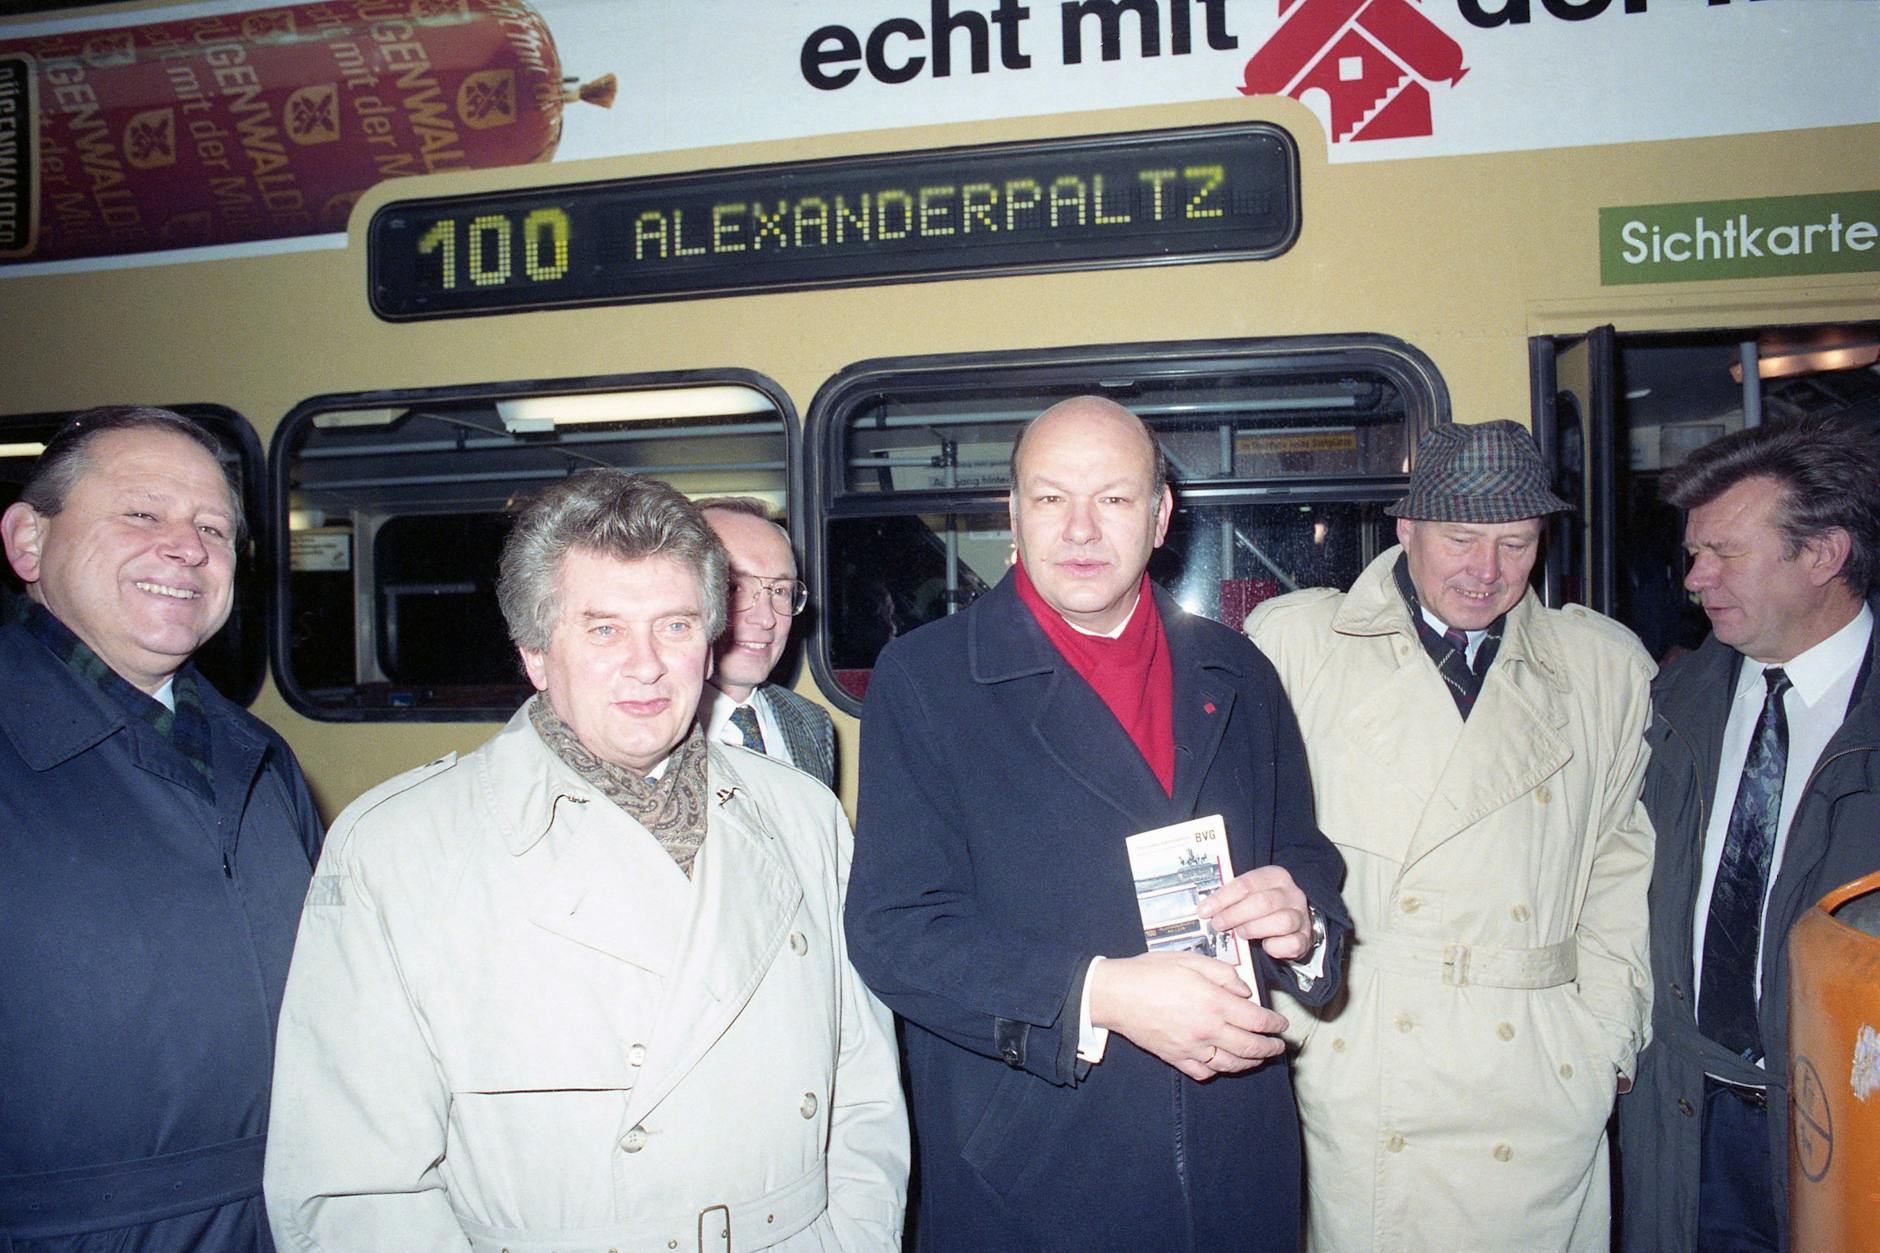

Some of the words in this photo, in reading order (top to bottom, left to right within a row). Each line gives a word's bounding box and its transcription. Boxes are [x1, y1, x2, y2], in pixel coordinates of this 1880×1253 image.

[329, 42, 380, 90] mit
[800, 0, 1031, 91] echt
[166, 66, 215, 115] mit
[189, 120, 230, 170] der
[354, 95, 398, 148] der
[418, 207, 570, 290] 100
[634, 166, 1223, 260] ALEXANDERPALTZ
[1621, 212, 1879, 264] Sichtkarte
[1194, 829, 1216, 843] BVG
